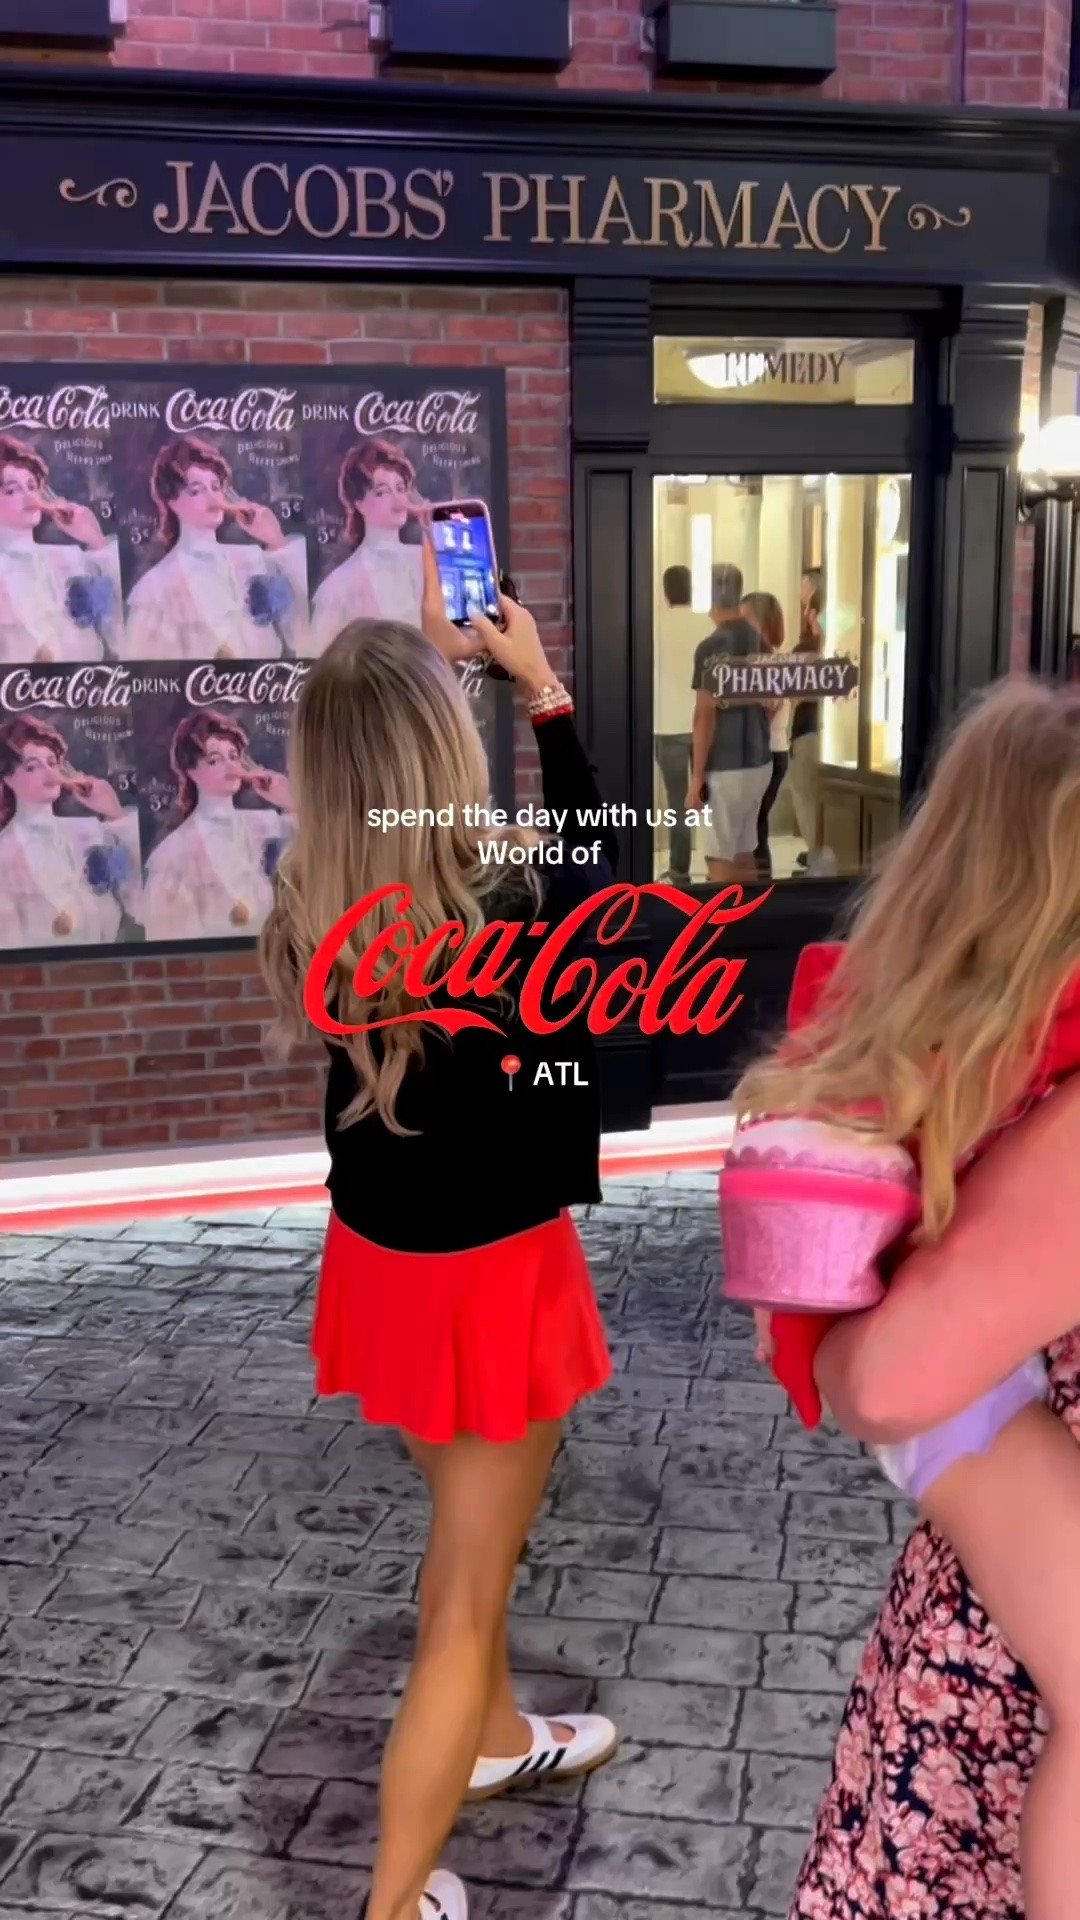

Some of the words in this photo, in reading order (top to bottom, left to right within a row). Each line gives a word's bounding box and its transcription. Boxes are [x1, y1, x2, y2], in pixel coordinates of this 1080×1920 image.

[153, 160, 454, 241] JACOBS'
[482, 172, 901, 253] PHARMACY
[724, 351, 845, 385] REMEDY
[111, 402, 160, 419] DRINK
[302, 404, 349, 421] DRINK
[132, 678, 181, 694] DRINK
[712, 663, 849, 698] PHARMACY
